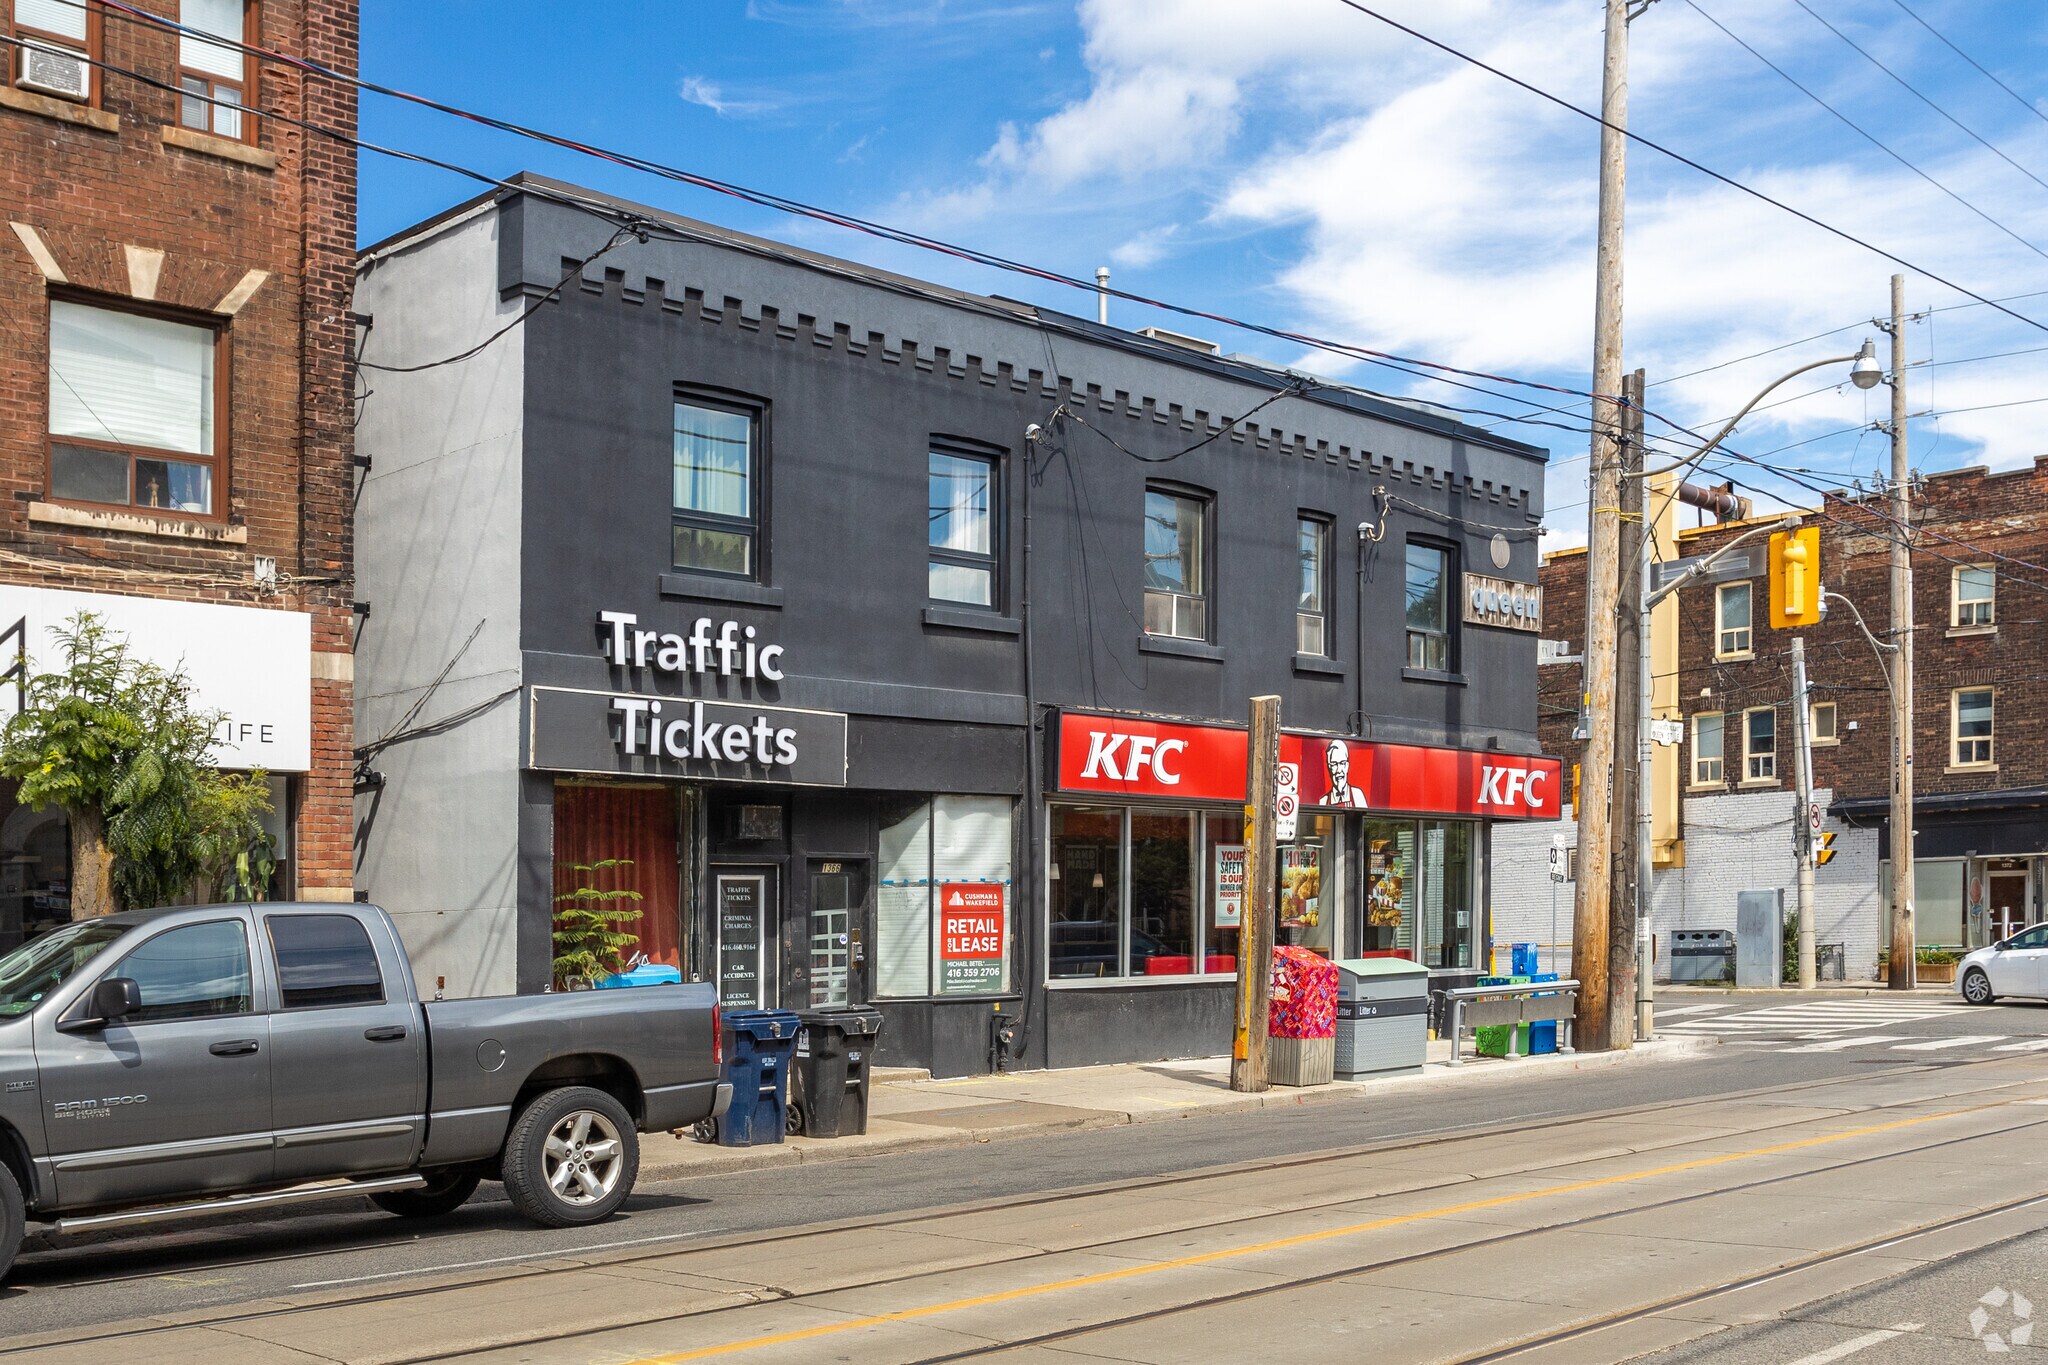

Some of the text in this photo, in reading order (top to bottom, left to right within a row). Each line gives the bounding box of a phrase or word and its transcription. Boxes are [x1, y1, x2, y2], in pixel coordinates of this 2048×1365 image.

[1473, 587, 1538, 619] queen
[597, 610, 785, 681] Traffic
[208, 720, 274, 744] LIFE
[609, 697, 798, 765] Tickets
[1080, 731, 1185, 785] KFC
[1477, 765, 1547, 808] KFC
[1311, 850, 1317, 867] 2
[1220, 874, 1227, 883] IS
[947, 918, 999, 934] RETAIL
[952, 936, 998, 953] LEASE
[723, 971, 755, 979] ACCIDENTS
[946, 967, 1000, 977] 416 359 2706
[721, 999, 756, 1007] SUSPENSIONS
[1336, 1006, 1352, 1016] Litter
[1359, 1006, 1371, 1015] Litter
[54, 1094, 148, 1112] RAM 1500
[54, 1107, 111, 1119] BIG HORN
